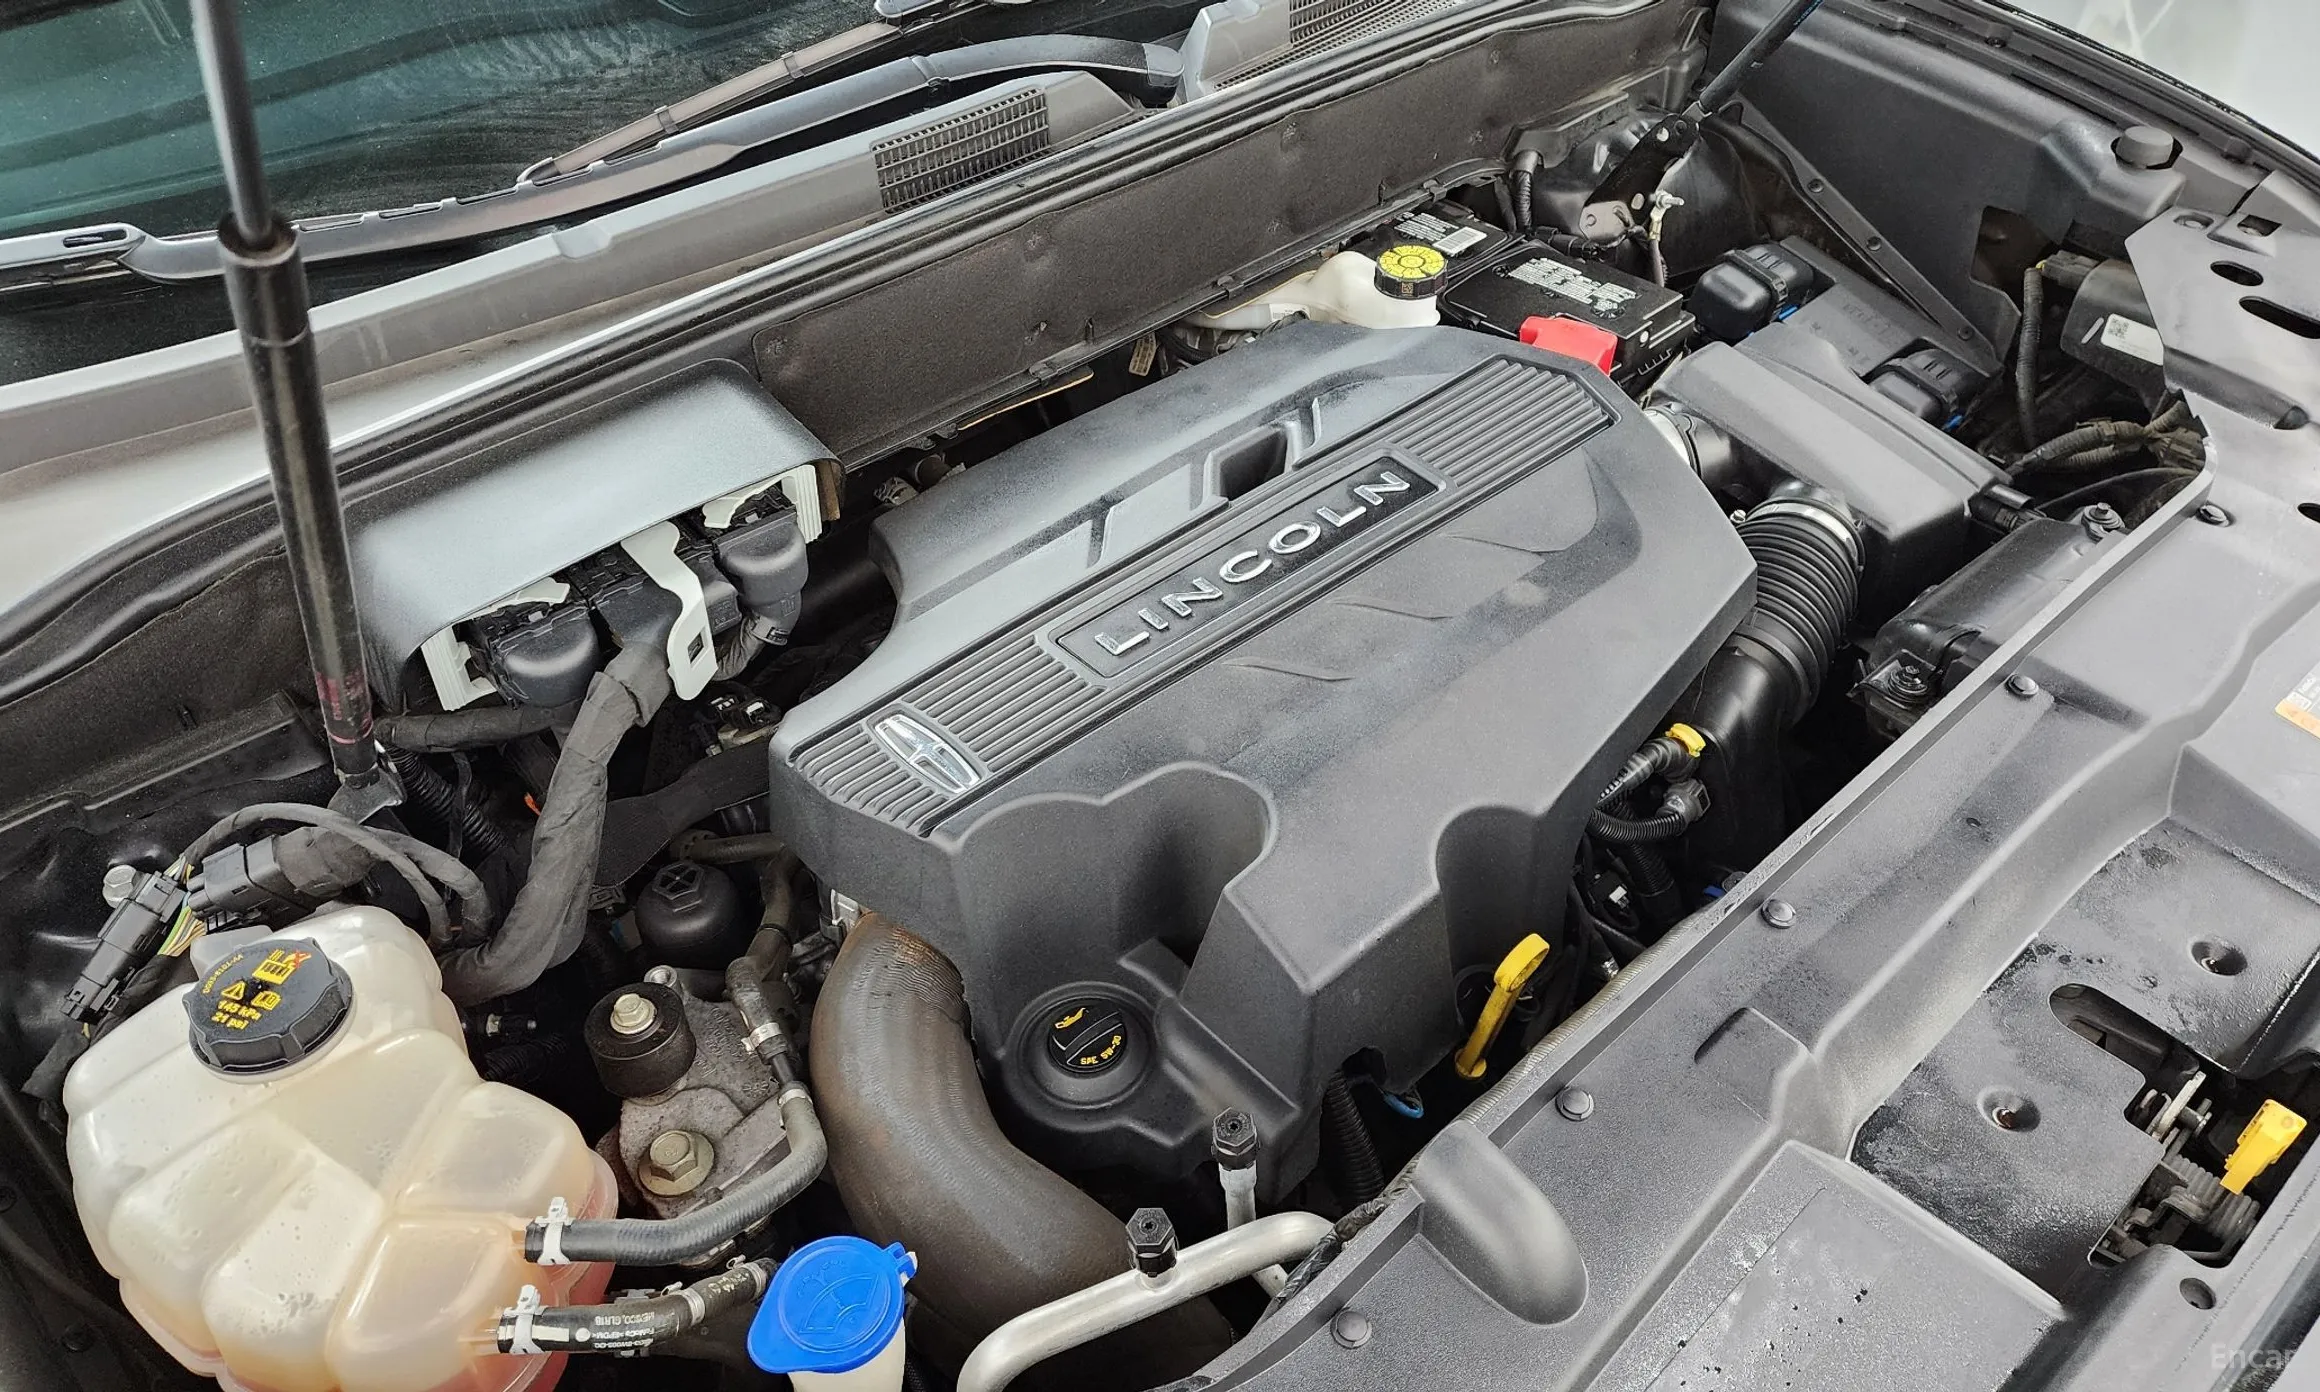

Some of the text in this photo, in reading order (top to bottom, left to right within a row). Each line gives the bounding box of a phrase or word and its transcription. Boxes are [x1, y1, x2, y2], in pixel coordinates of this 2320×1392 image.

[1094, 471, 1411, 656] LINCOLN
[217, 1000, 261, 1020] 145 kPa
[211, 1011, 249, 1030] 21 psi
[1080, 1055, 1099, 1065] SAE
